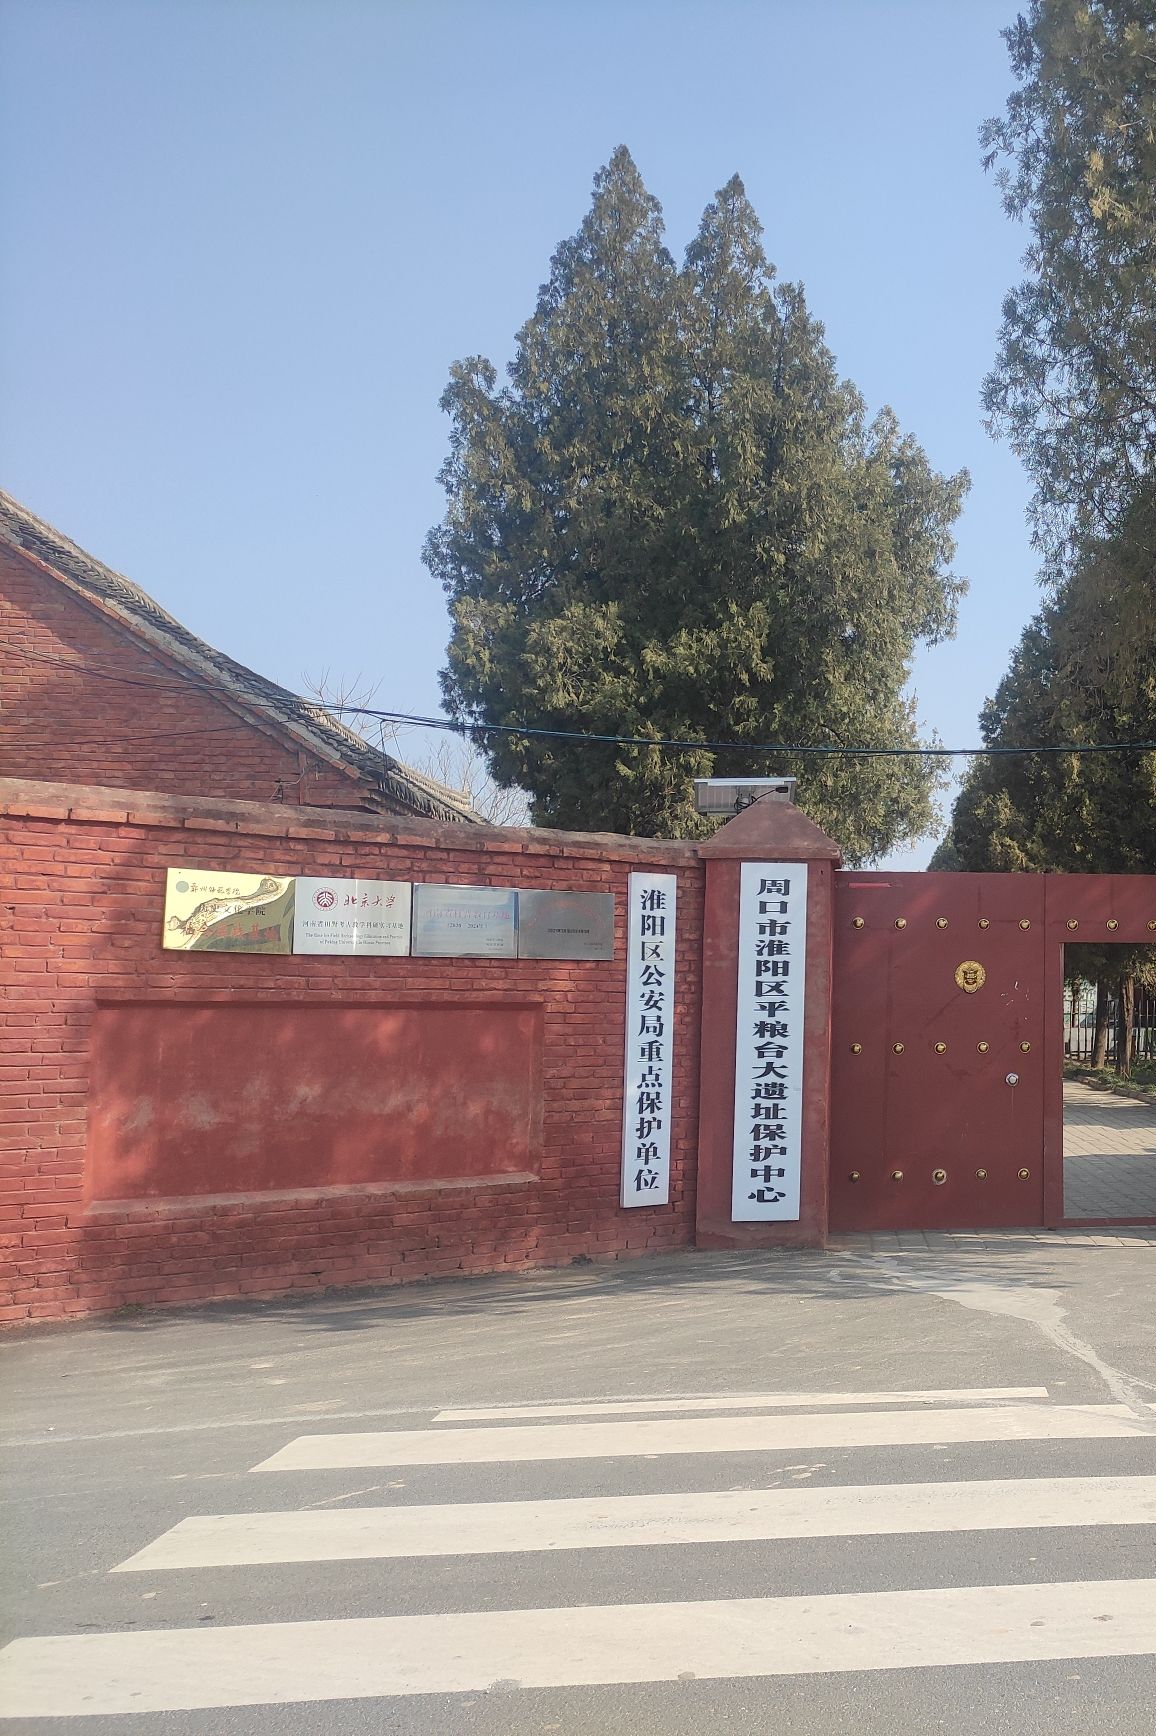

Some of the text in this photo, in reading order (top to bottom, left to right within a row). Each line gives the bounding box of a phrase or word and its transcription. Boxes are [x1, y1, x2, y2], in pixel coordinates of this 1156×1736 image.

[344, 893, 396, 909] 北京大学
[634, 889, 667, 1191] 淮阳区公安局重点保护单位
[748, 878, 792, 1203] 周口市淮阳区平粮台大遗址保护中心
